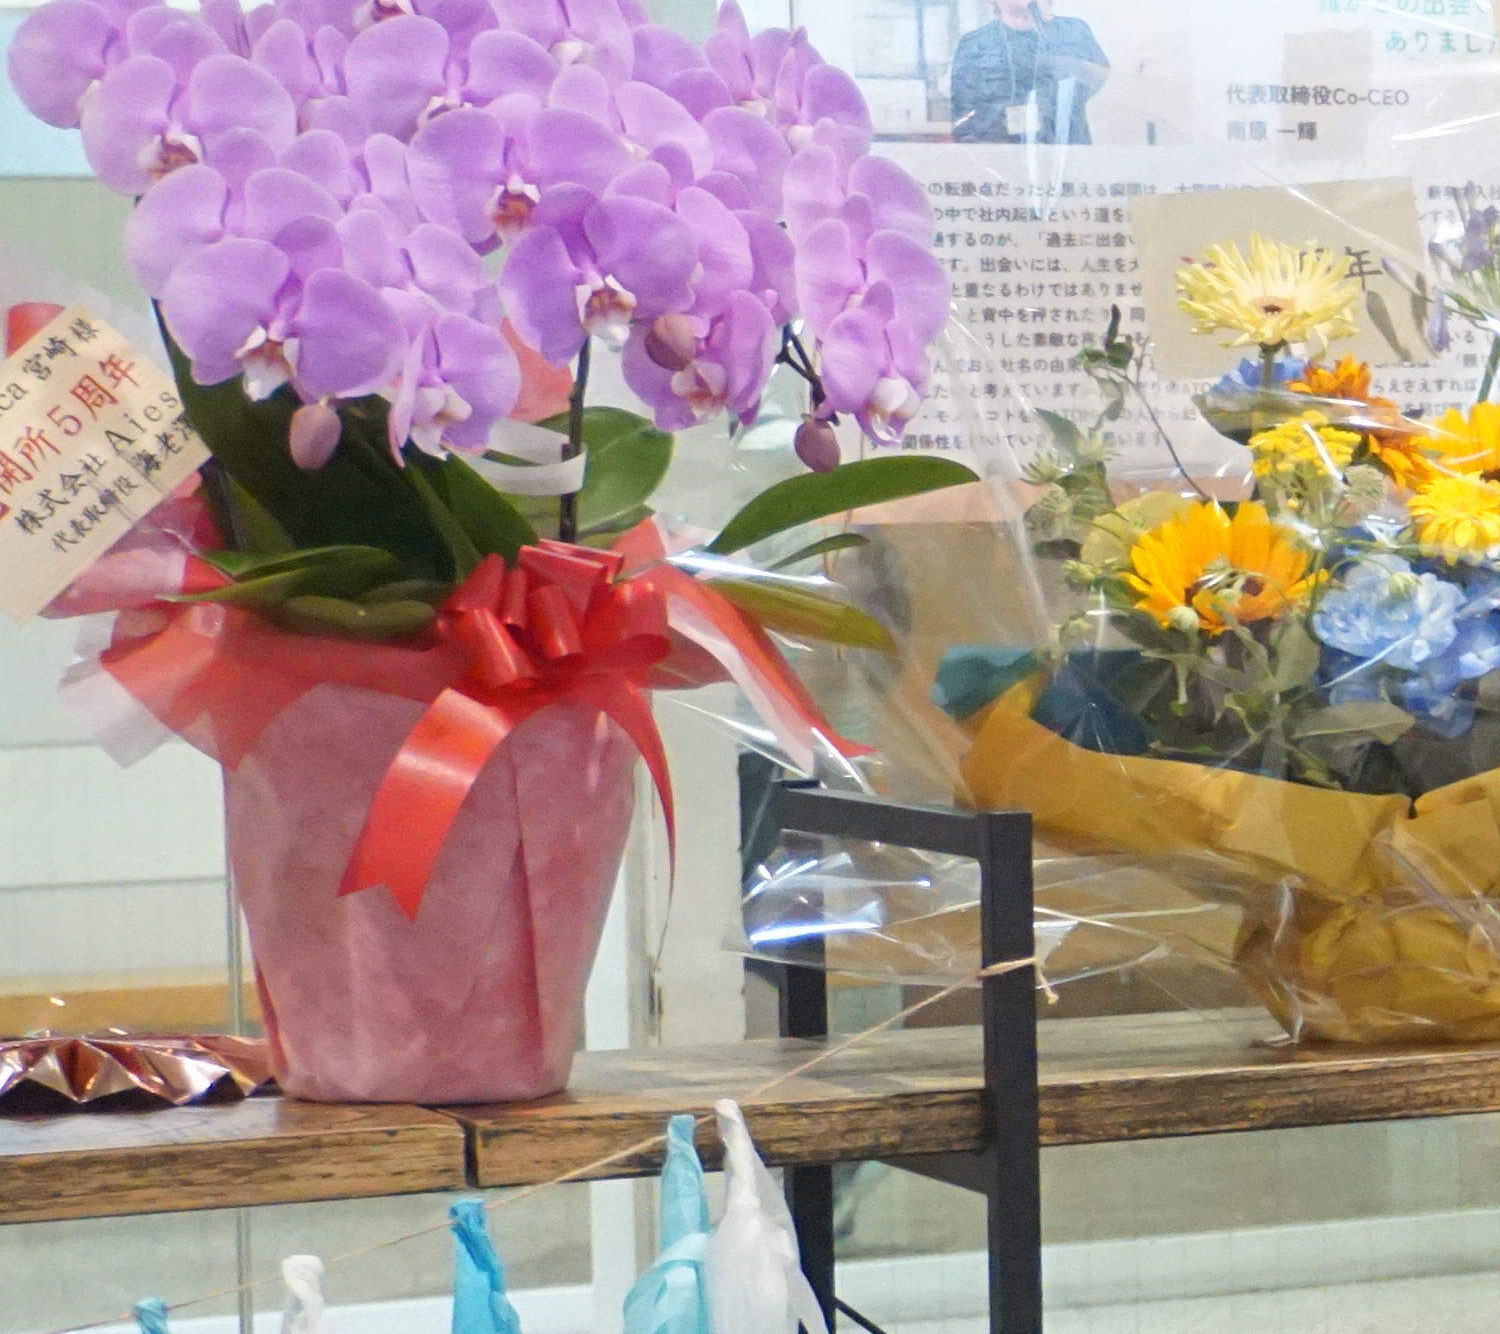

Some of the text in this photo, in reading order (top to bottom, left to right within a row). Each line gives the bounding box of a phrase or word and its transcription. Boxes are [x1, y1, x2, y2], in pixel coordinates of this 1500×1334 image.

[1225, 82, 1409, 109] 代表取締役Co-CEO
